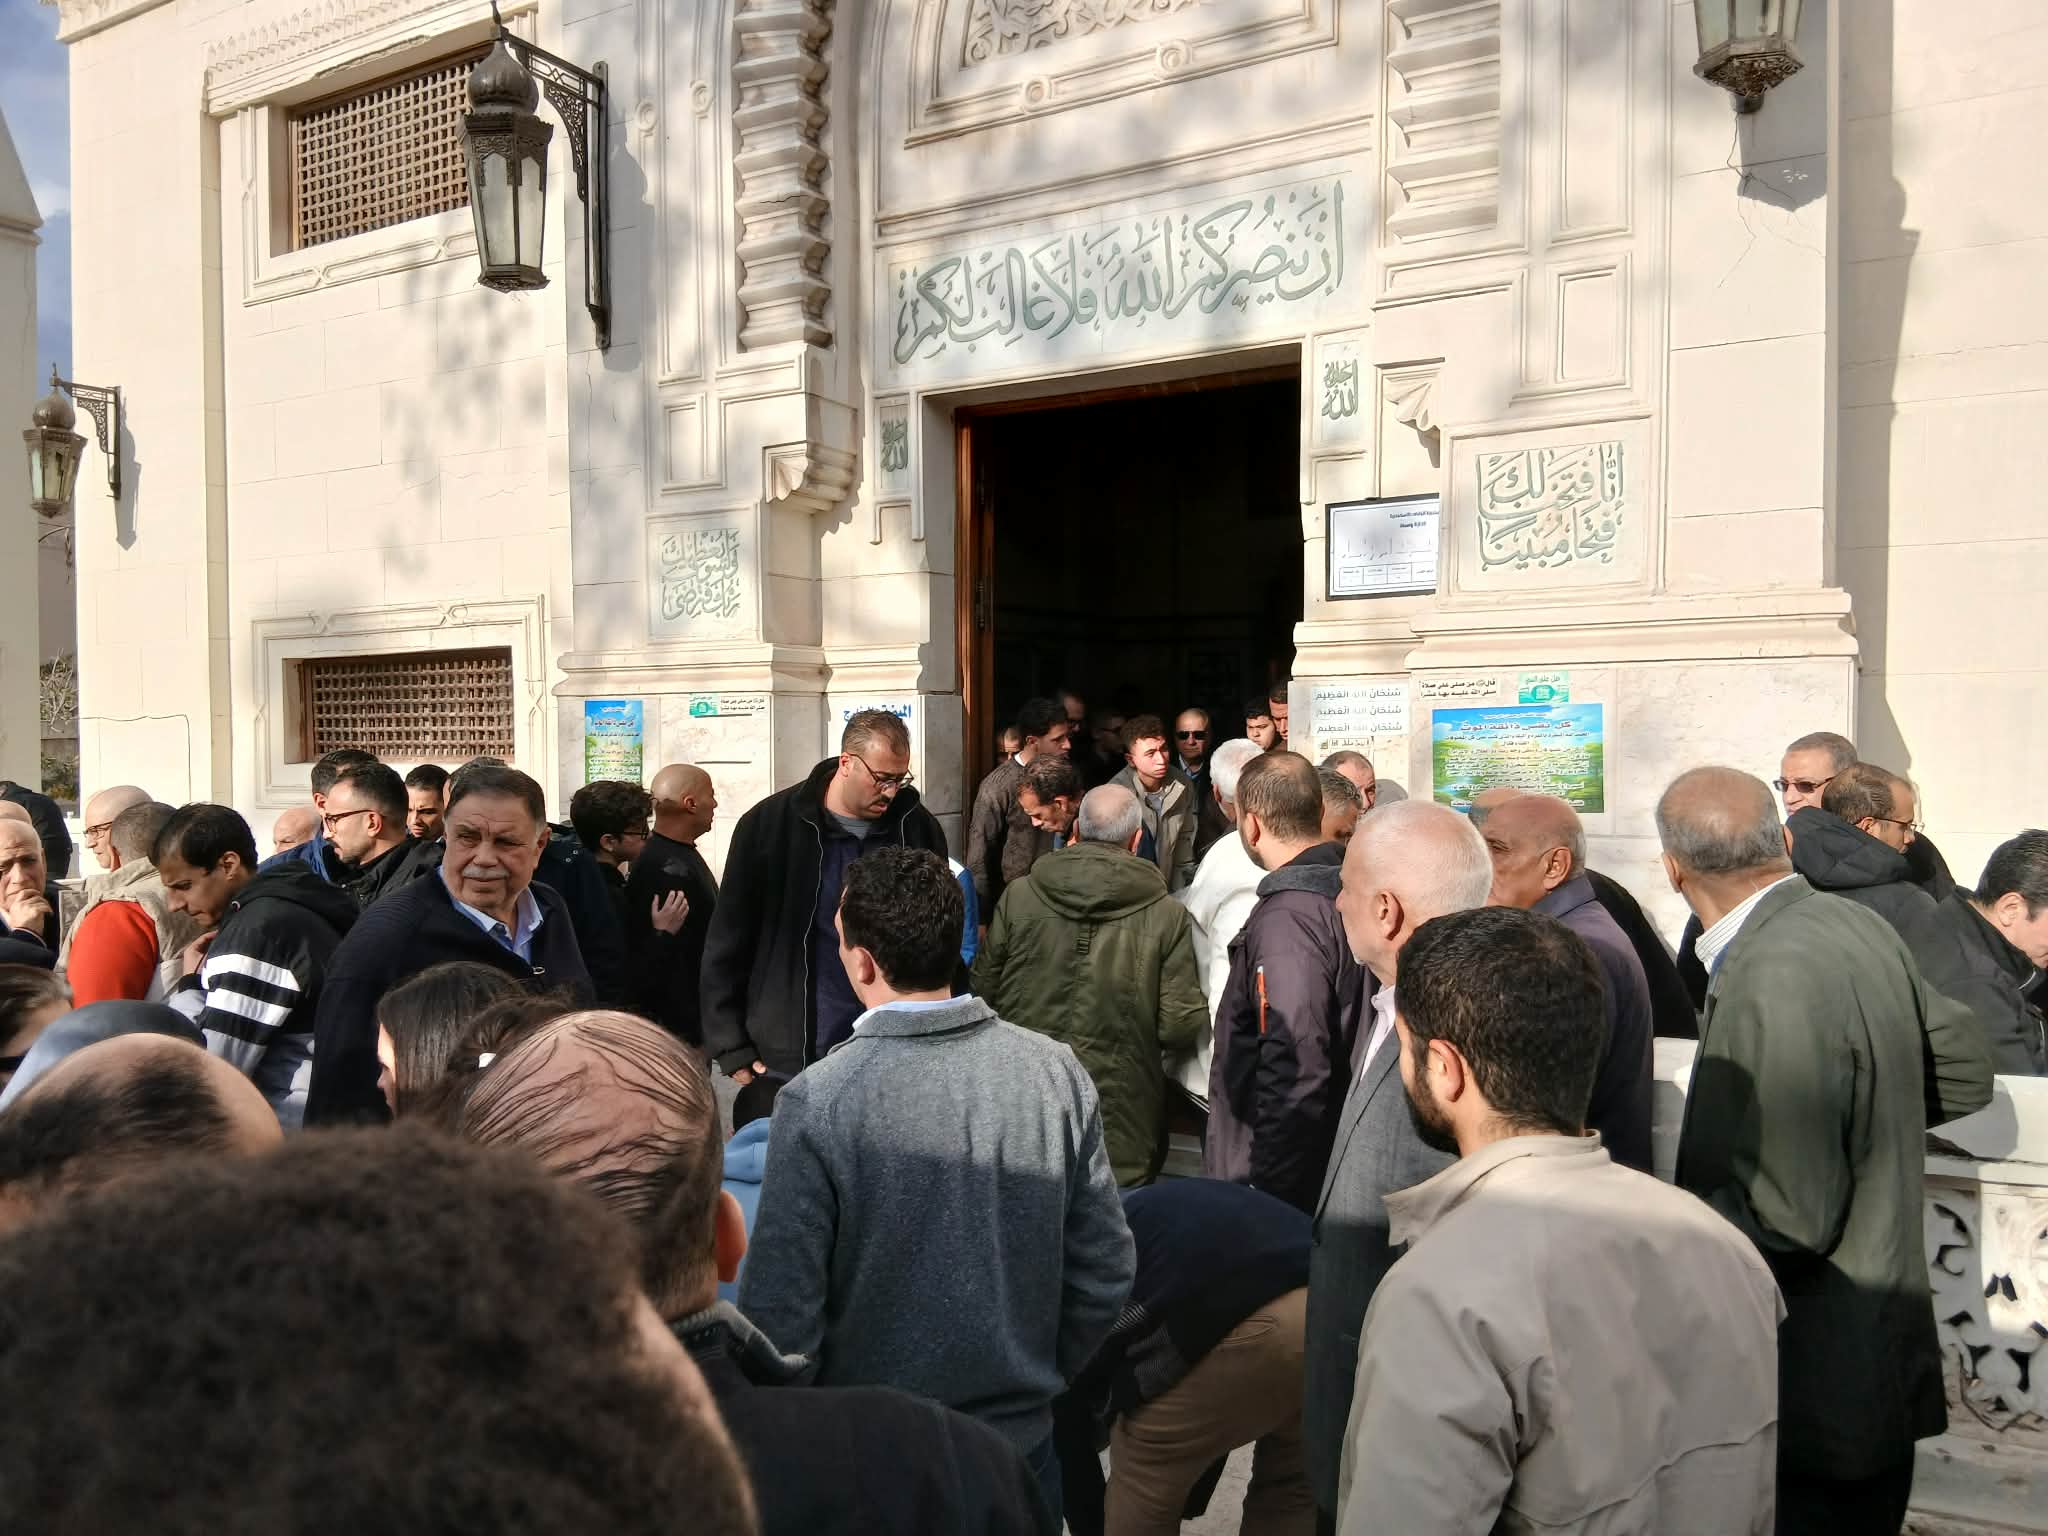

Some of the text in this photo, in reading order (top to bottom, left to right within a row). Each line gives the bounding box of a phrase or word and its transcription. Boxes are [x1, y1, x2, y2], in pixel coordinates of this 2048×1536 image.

[894, 256, 974, 364] لكم
[948, 247, 1055, 353] غالب
[1031, 234, 1097, 340] فلا
[1104, 216, 1174, 321] الله
